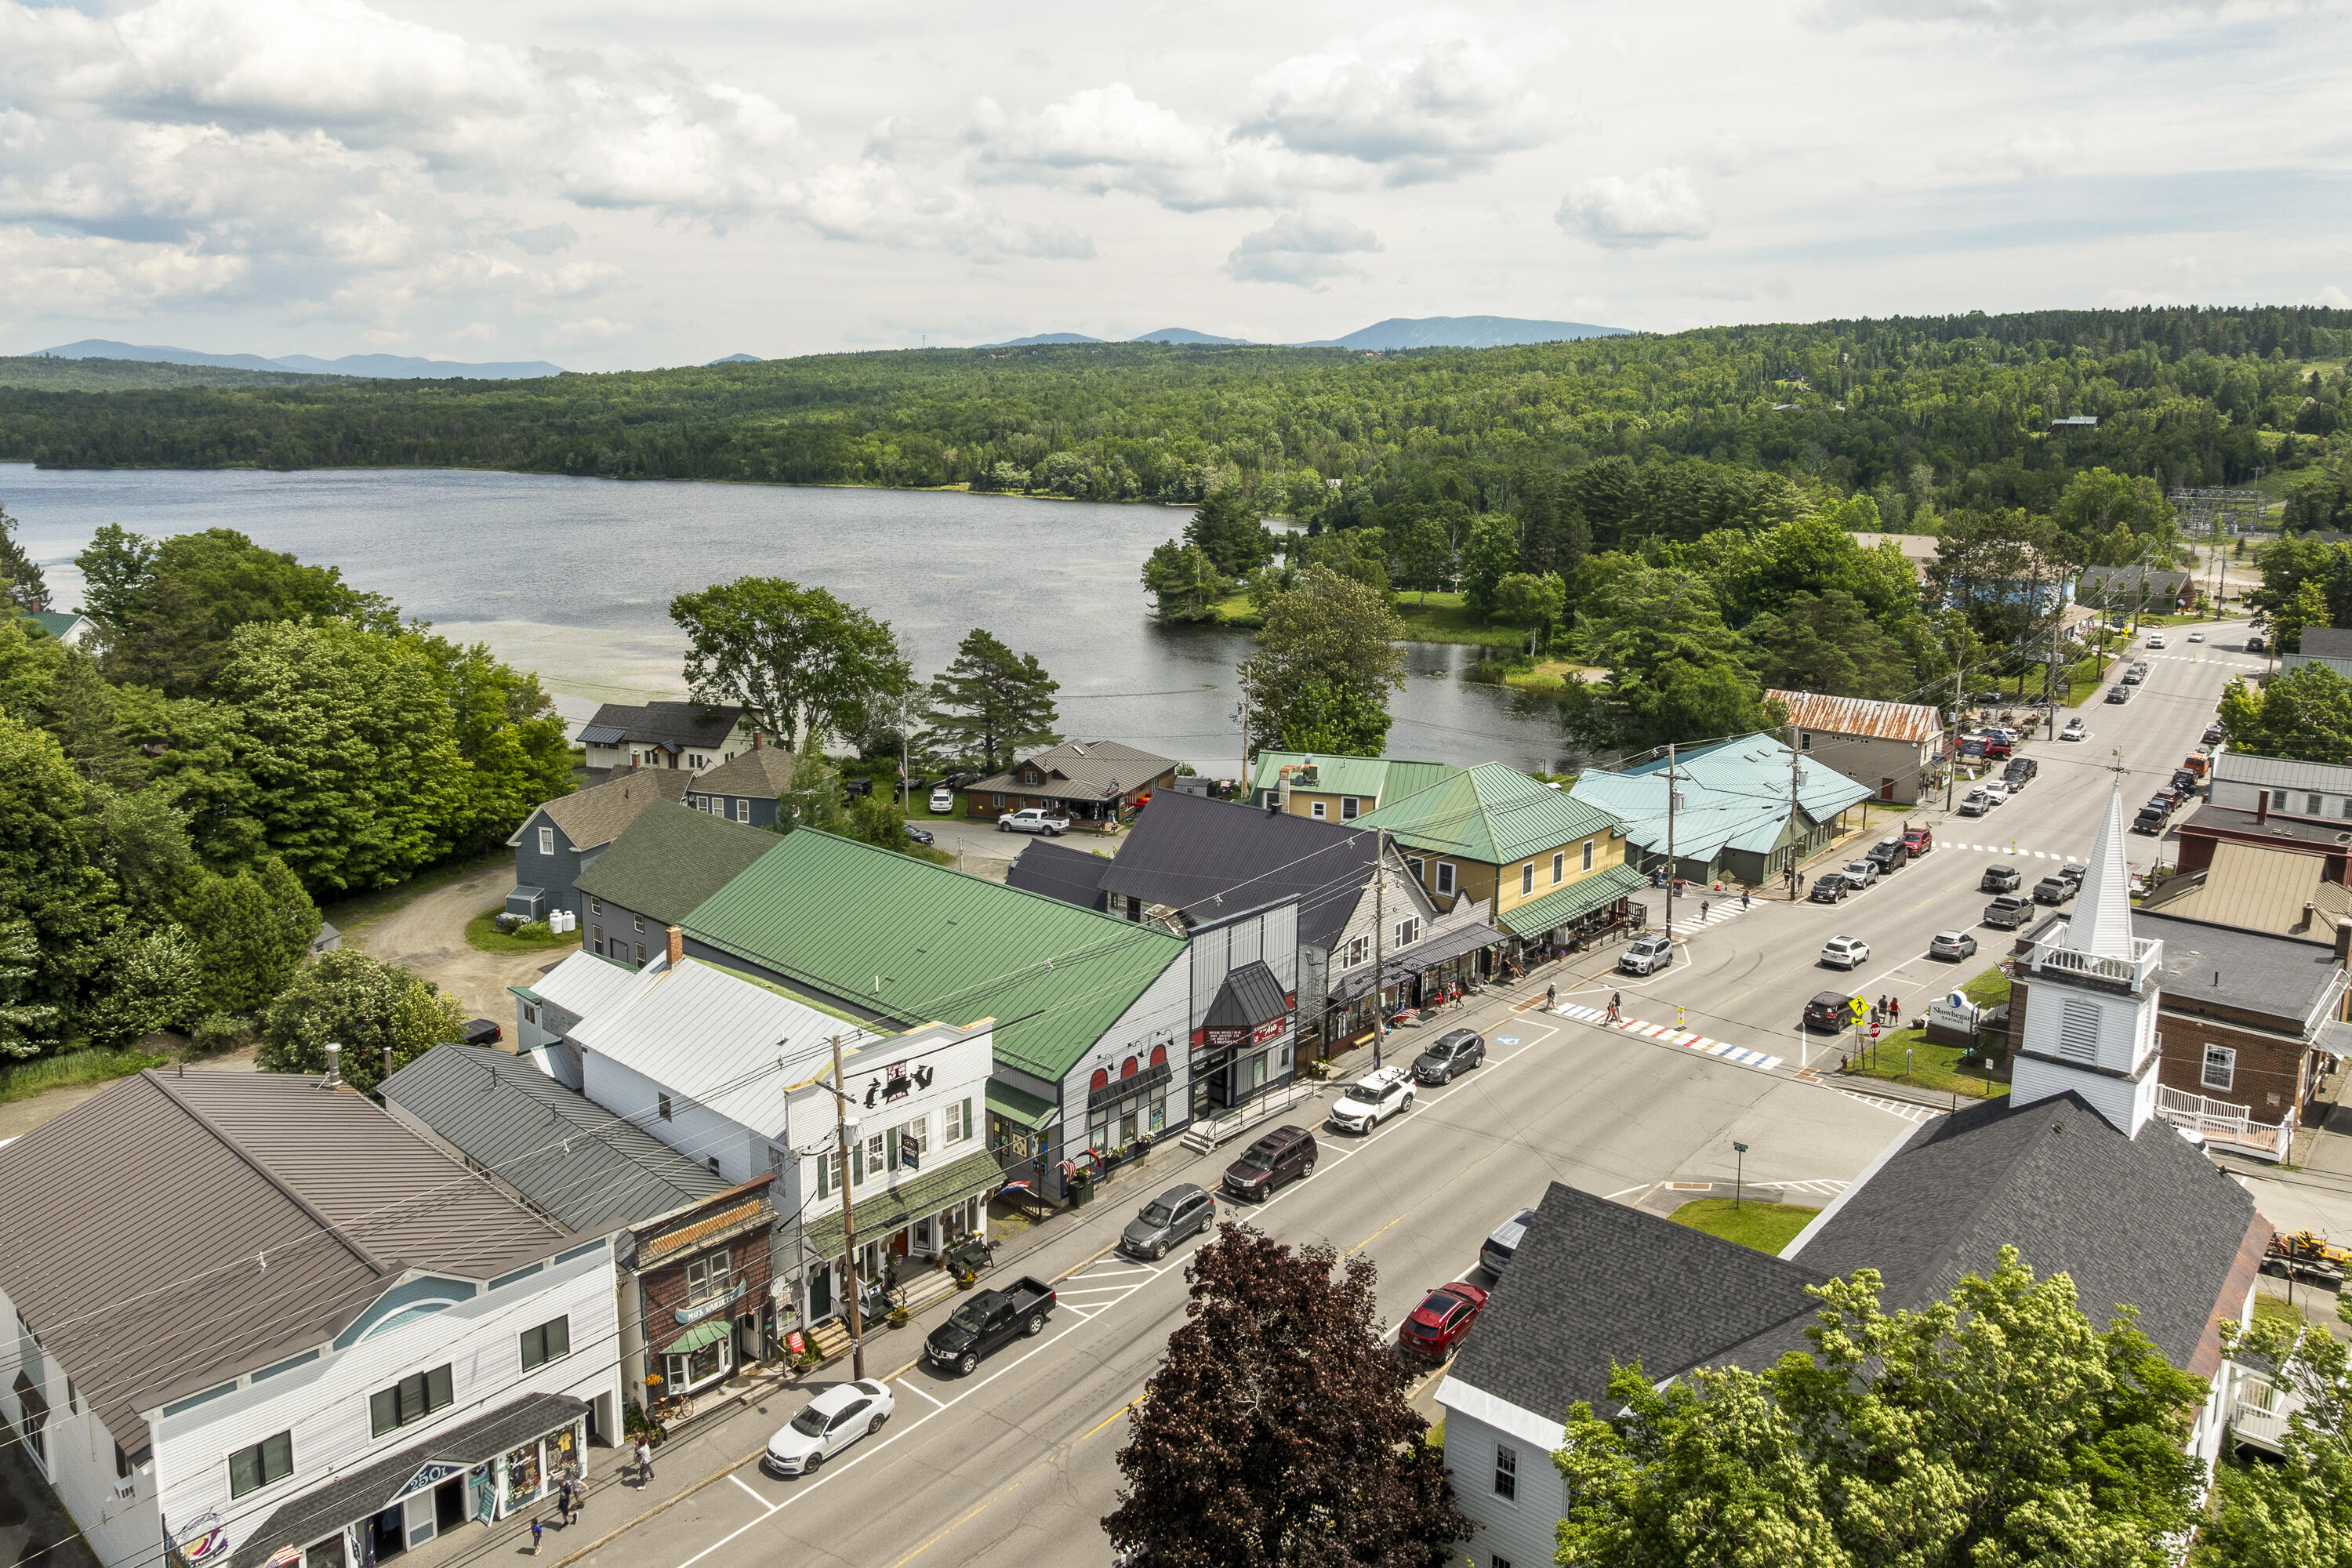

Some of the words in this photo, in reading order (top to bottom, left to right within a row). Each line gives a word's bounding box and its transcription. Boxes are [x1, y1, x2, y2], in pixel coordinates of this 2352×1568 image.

[1941, 1015, 1963, 1024] SAVINGS
[706, 1294, 734, 1312] VARIETY
[410, 1466, 448, 1492] 2501
